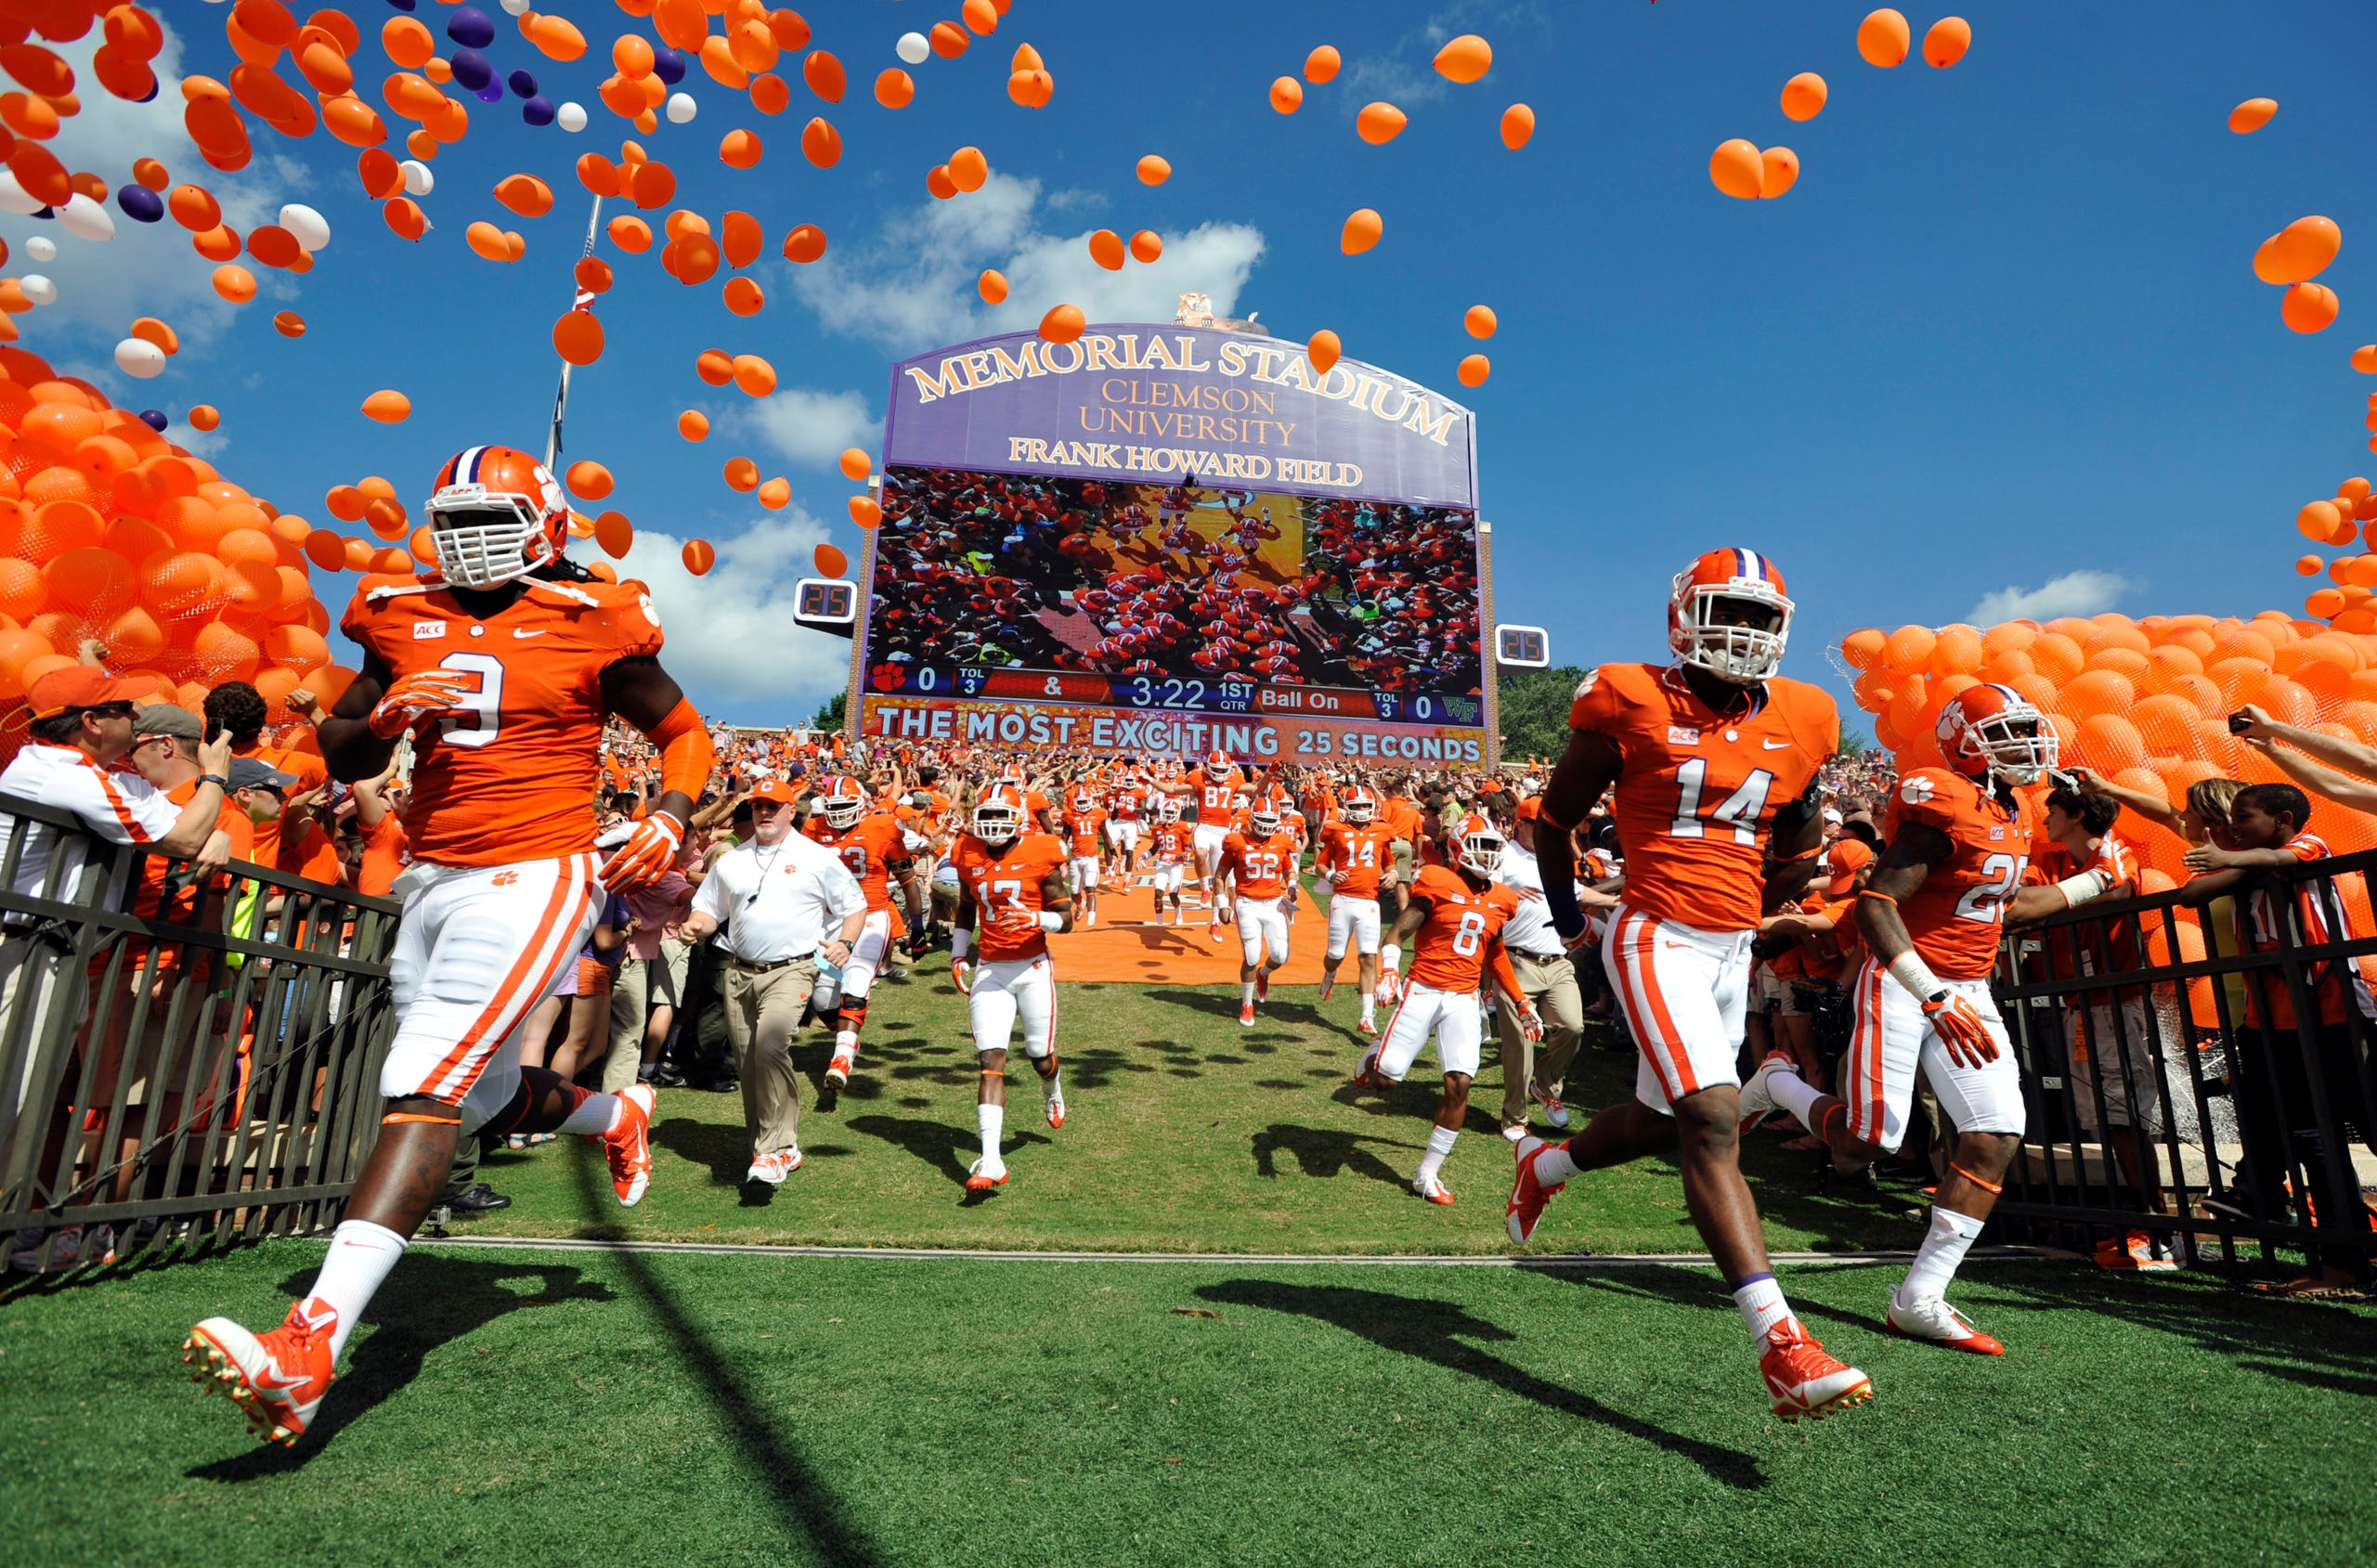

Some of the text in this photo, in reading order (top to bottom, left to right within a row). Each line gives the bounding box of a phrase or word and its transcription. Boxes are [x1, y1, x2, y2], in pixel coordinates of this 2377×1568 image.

[905, 334, 1460, 447] MEMORIAL STADIUM
[1102, 378, 1276, 415] CLEMSON
[1079, 406, 1297, 447] UNIVERSITY
[1008, 437, 1363, 486] FRANK HOWARD FIELD
[805, 586, 846, 615] 25
[416, 624, 444, 635] ACC
[1505, 631, 1540, 659] 25
[918, 667, 936, 692] 0
[959, 667, 984, 679] TOL
[964, 679, 975, 694] 3
[1044, 676, 1061, 695] &
[1131, 677, 1205, 708] 3:22
[1218, 682, 1253, 698] 1ST
[1220, 700, 1246, 711] QTR
[1262, 689, 1339, 710] Ball On
[1374, 693, 1398, 704] TOL
[1415, 696, 1431, 719] 0
[1442, 696, 1477, 722] WF
[1381, 703, 1392, 718] 3
[877, 706, 1481, 762] THE MOST EXCITING 25 SECONDS
[1670, 729, 1698, 742] ACC
[760, 781, 773, 792] C
[1204, 786, 1232, 809] 87
[1670, 757, 1774, 847] 14
[1079, 821, 1094, 836] 11
[1158, 835, 1176, 851] 38
[1346, 839, 1374, 868] 14
[1244, 852, 1279, 880] 52
[1826, 862, 1836, 875] C
[977, 879, 1022, 922] 17
[1452, 910, 1487, 957] 8
